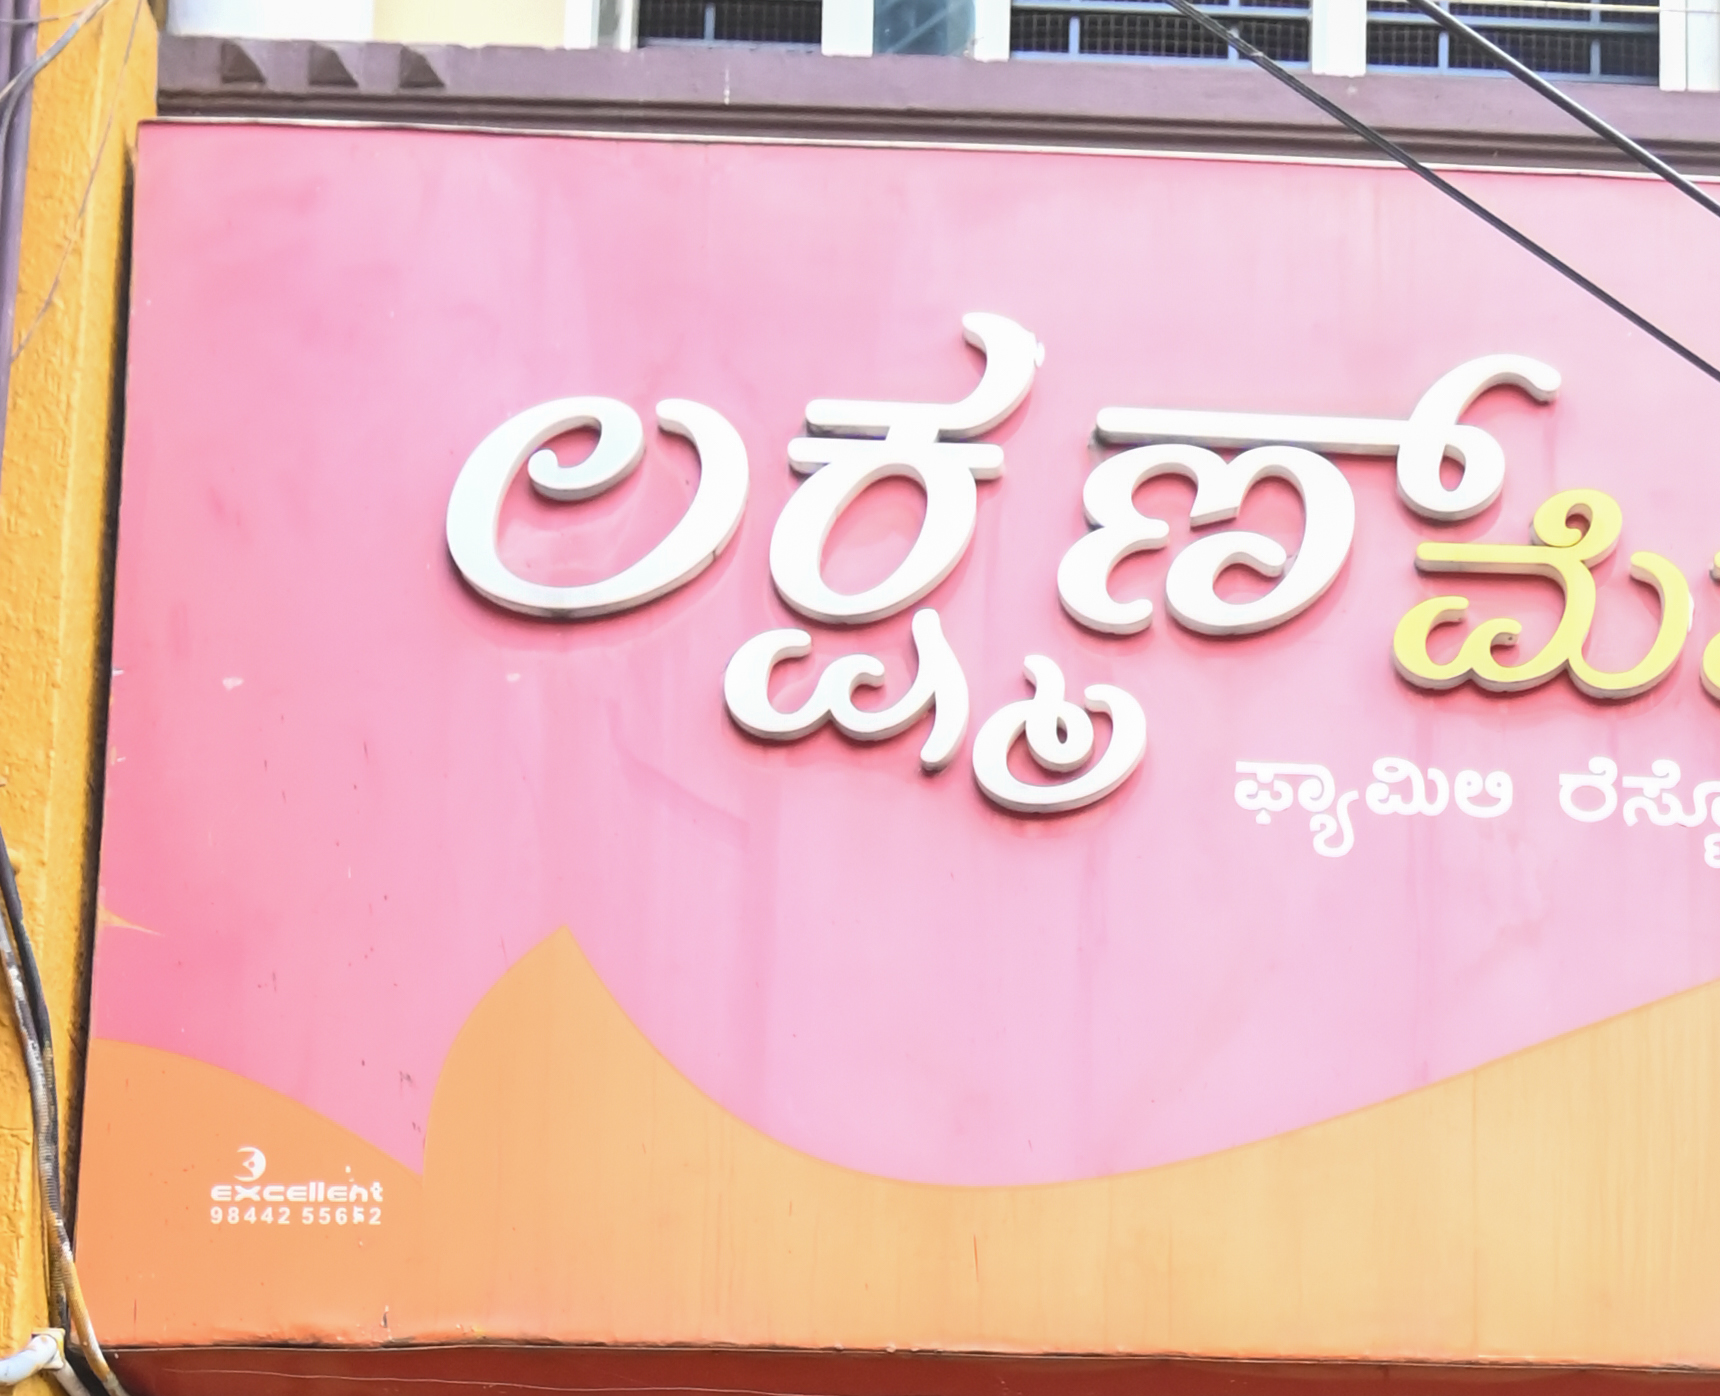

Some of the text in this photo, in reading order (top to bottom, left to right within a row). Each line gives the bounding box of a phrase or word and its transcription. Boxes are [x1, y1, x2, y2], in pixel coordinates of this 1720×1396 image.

[1233, 755, 1513, 857] ಫ್ಯಾಮಿಲಿ
[210, 1181, 383, 1202] excellent
[210, 1206, 290, 1224] 98442
